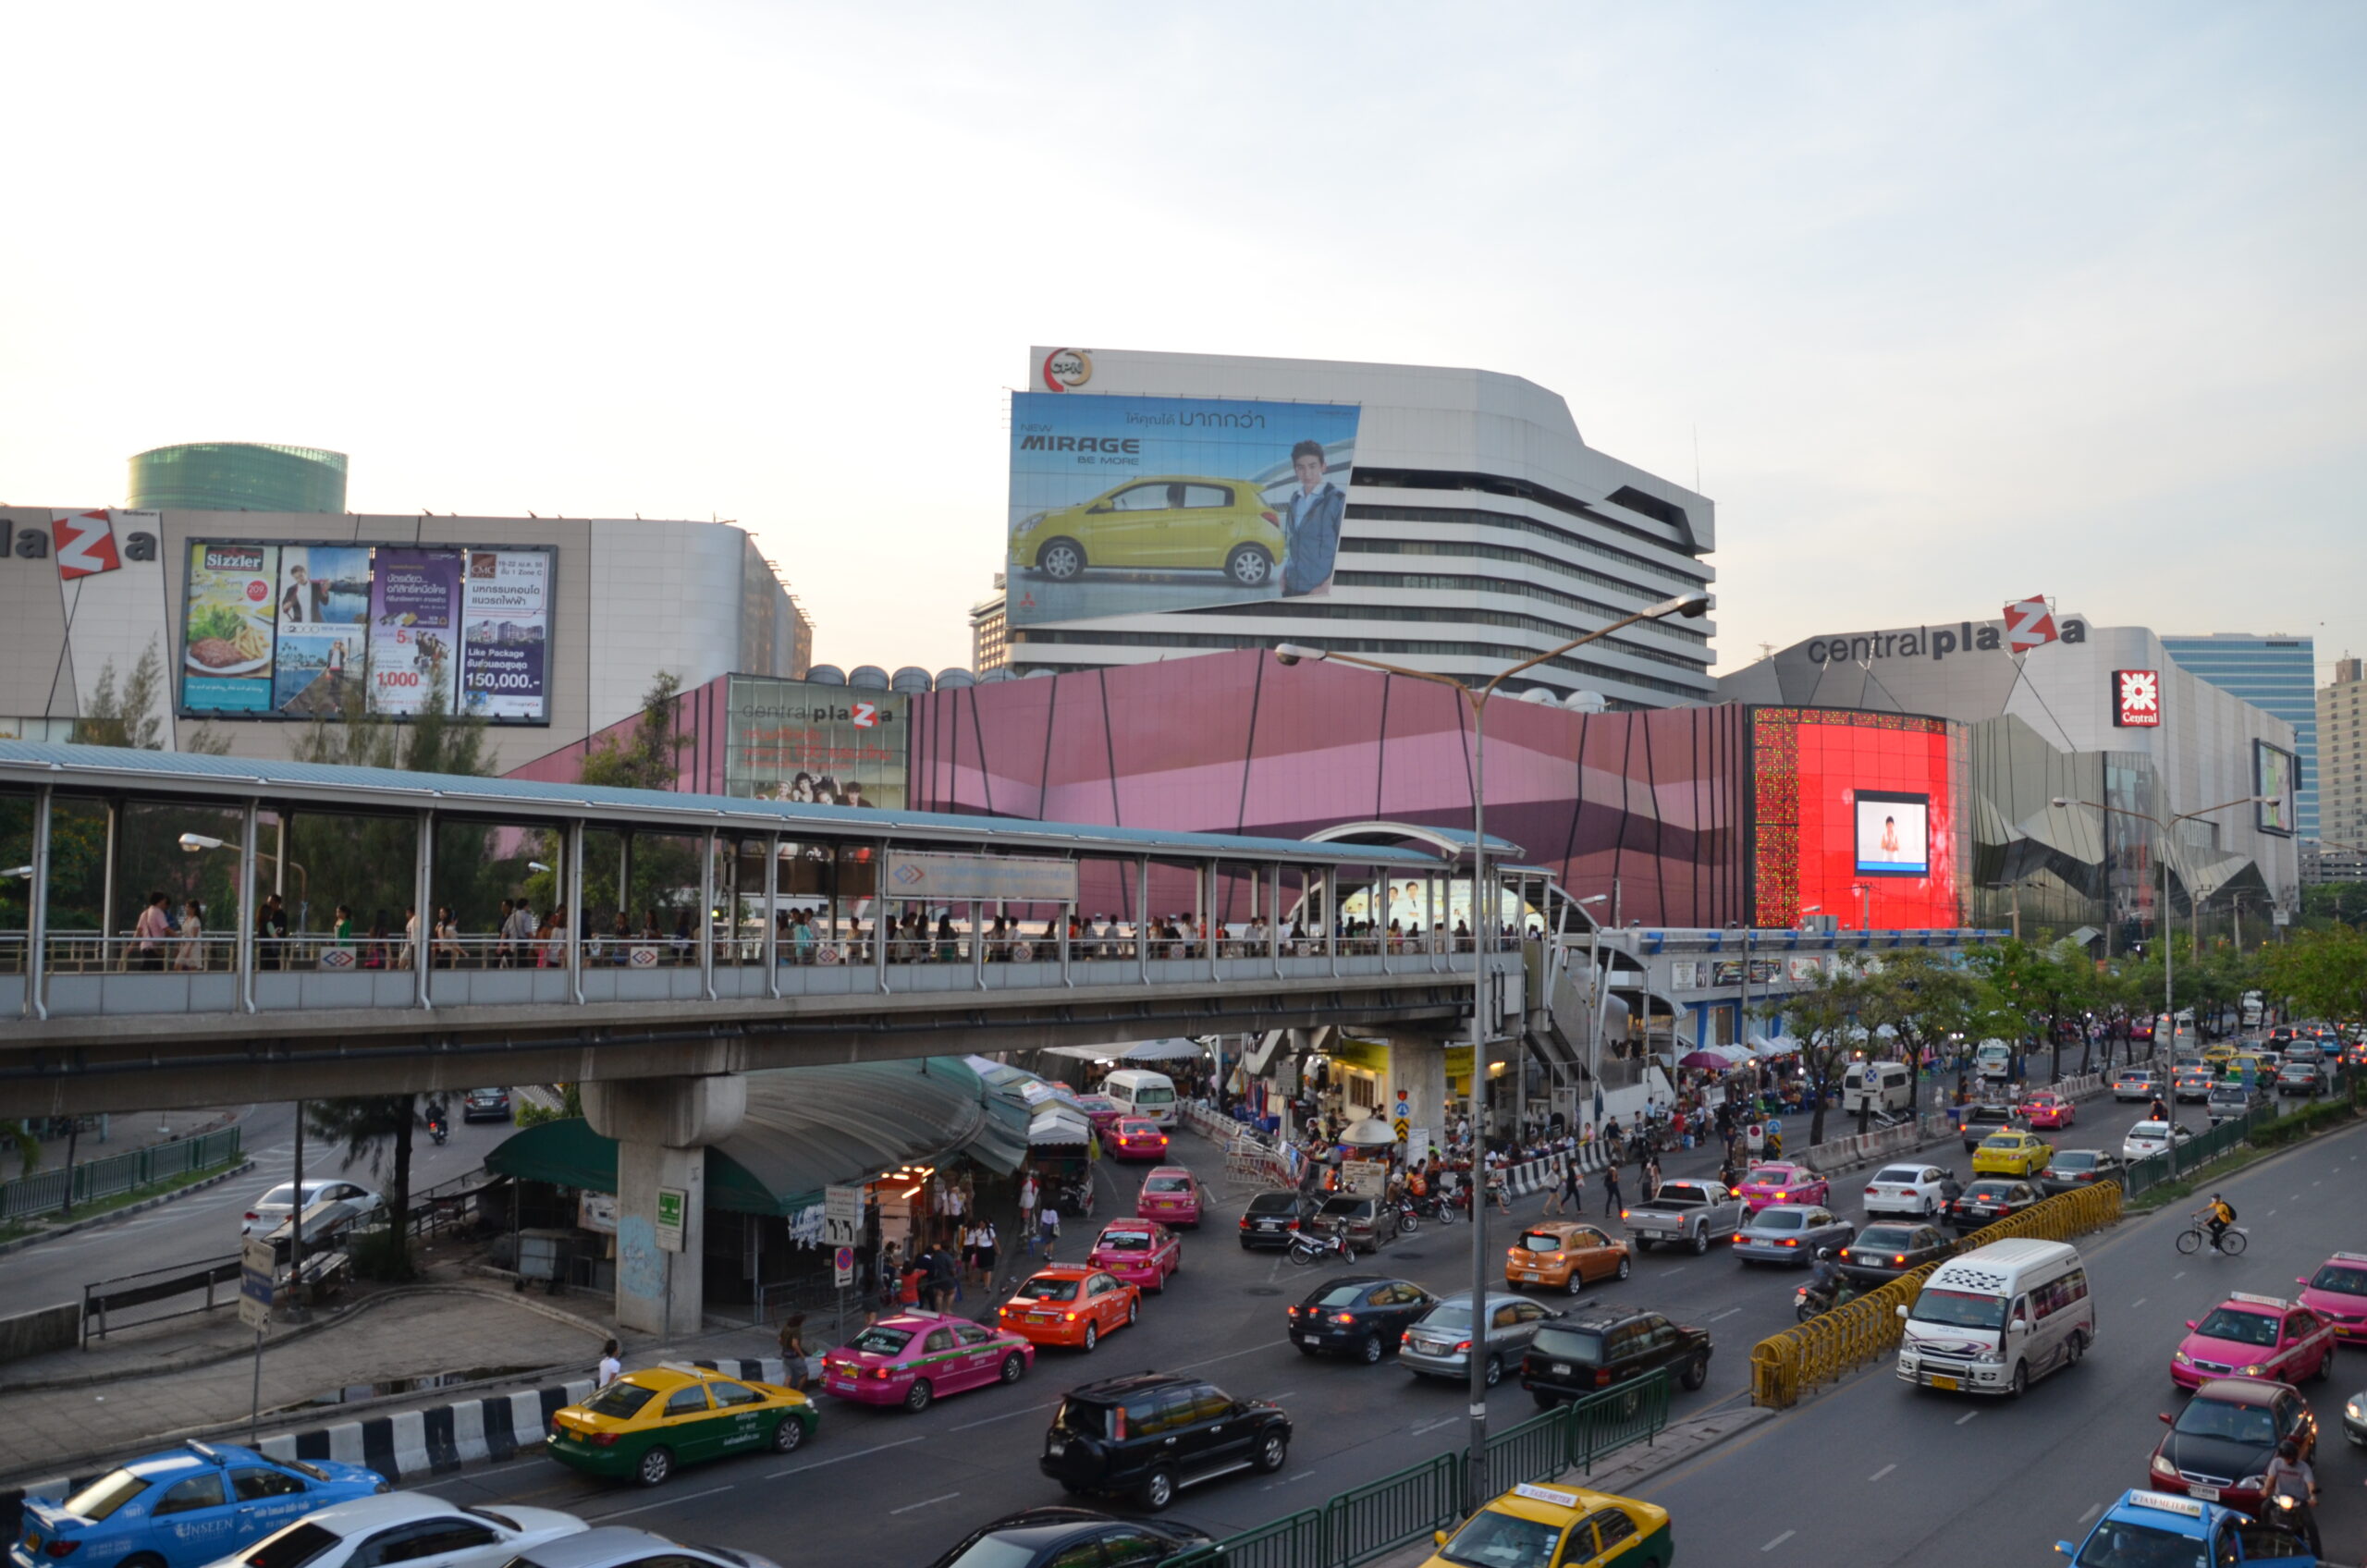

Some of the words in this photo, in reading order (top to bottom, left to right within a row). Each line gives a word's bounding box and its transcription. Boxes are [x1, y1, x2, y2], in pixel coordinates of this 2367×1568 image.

[1125, 412, 1175, 428] ให้คุณได้
[1180, 411, 1265, 428] มากกว่า
[1021, 423, 1052, 433] NEW
[1020, 435, 1139, 454] MIRAGE
[1077, 456, 1096, 464] BE
[1100, 457, 1139, 465] MORE
[207, 554, 261, 567] Sizzler
[472, 584, 540, 594] มหกรรมคอนโด
[472, 594, 526, 606] แนวรถไฟฟ้า
[468, 648, 485, 656] Like
[488, 649, 524, 658] Package
[466, 673, 540, 689] 150,000.-
[2122, 712, 2157, 724] Central
[176, 1519, 234, 1537] UNSEEN
